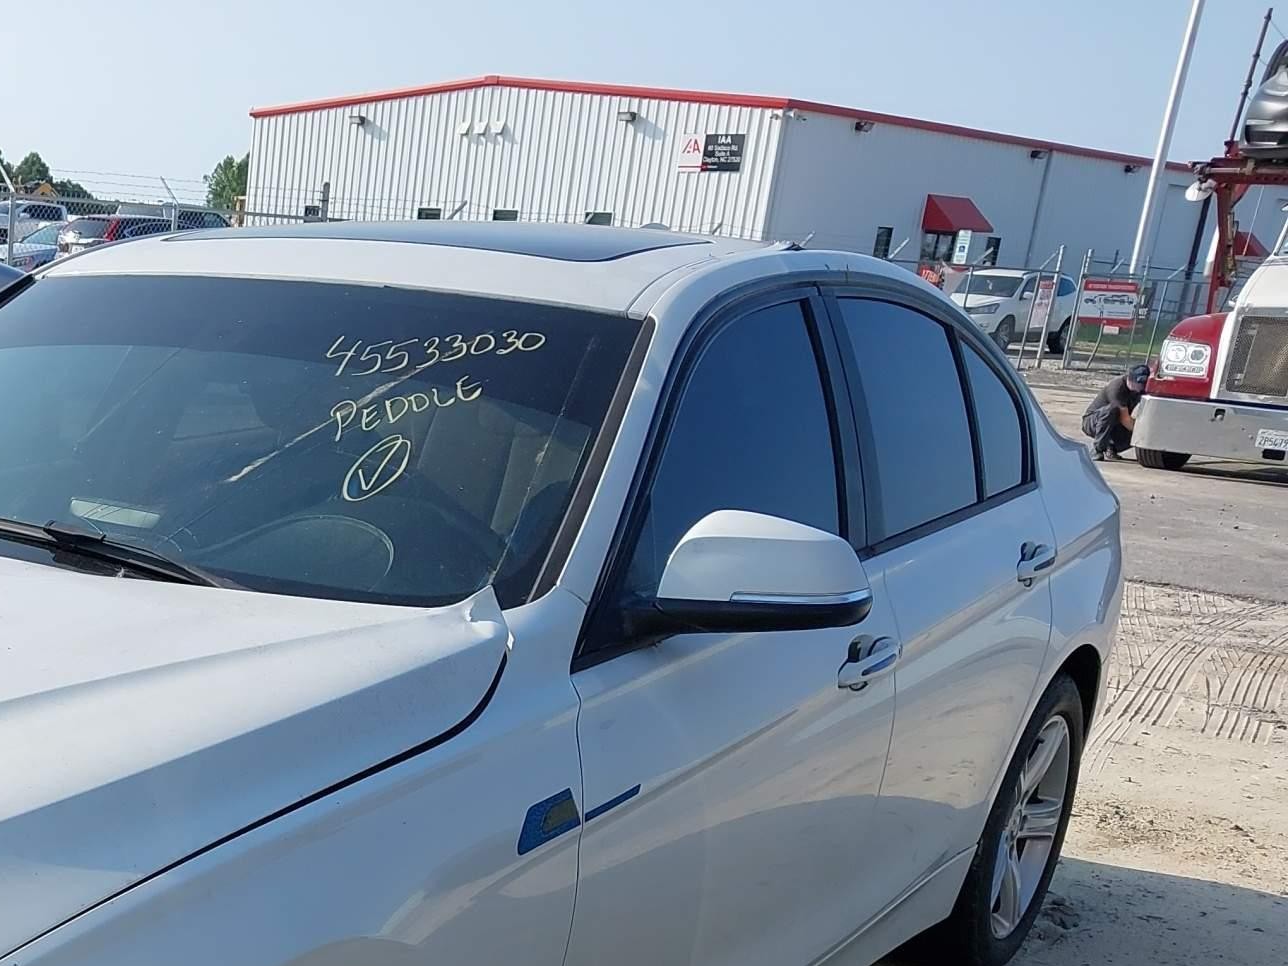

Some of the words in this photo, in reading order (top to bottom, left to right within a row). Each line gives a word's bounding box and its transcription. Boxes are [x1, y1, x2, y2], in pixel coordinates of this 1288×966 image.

[718, 135, 732, 144] IAA
[325, 330, 546, 377] 45533030
[330, 376, 482, 441] PEDDLE
